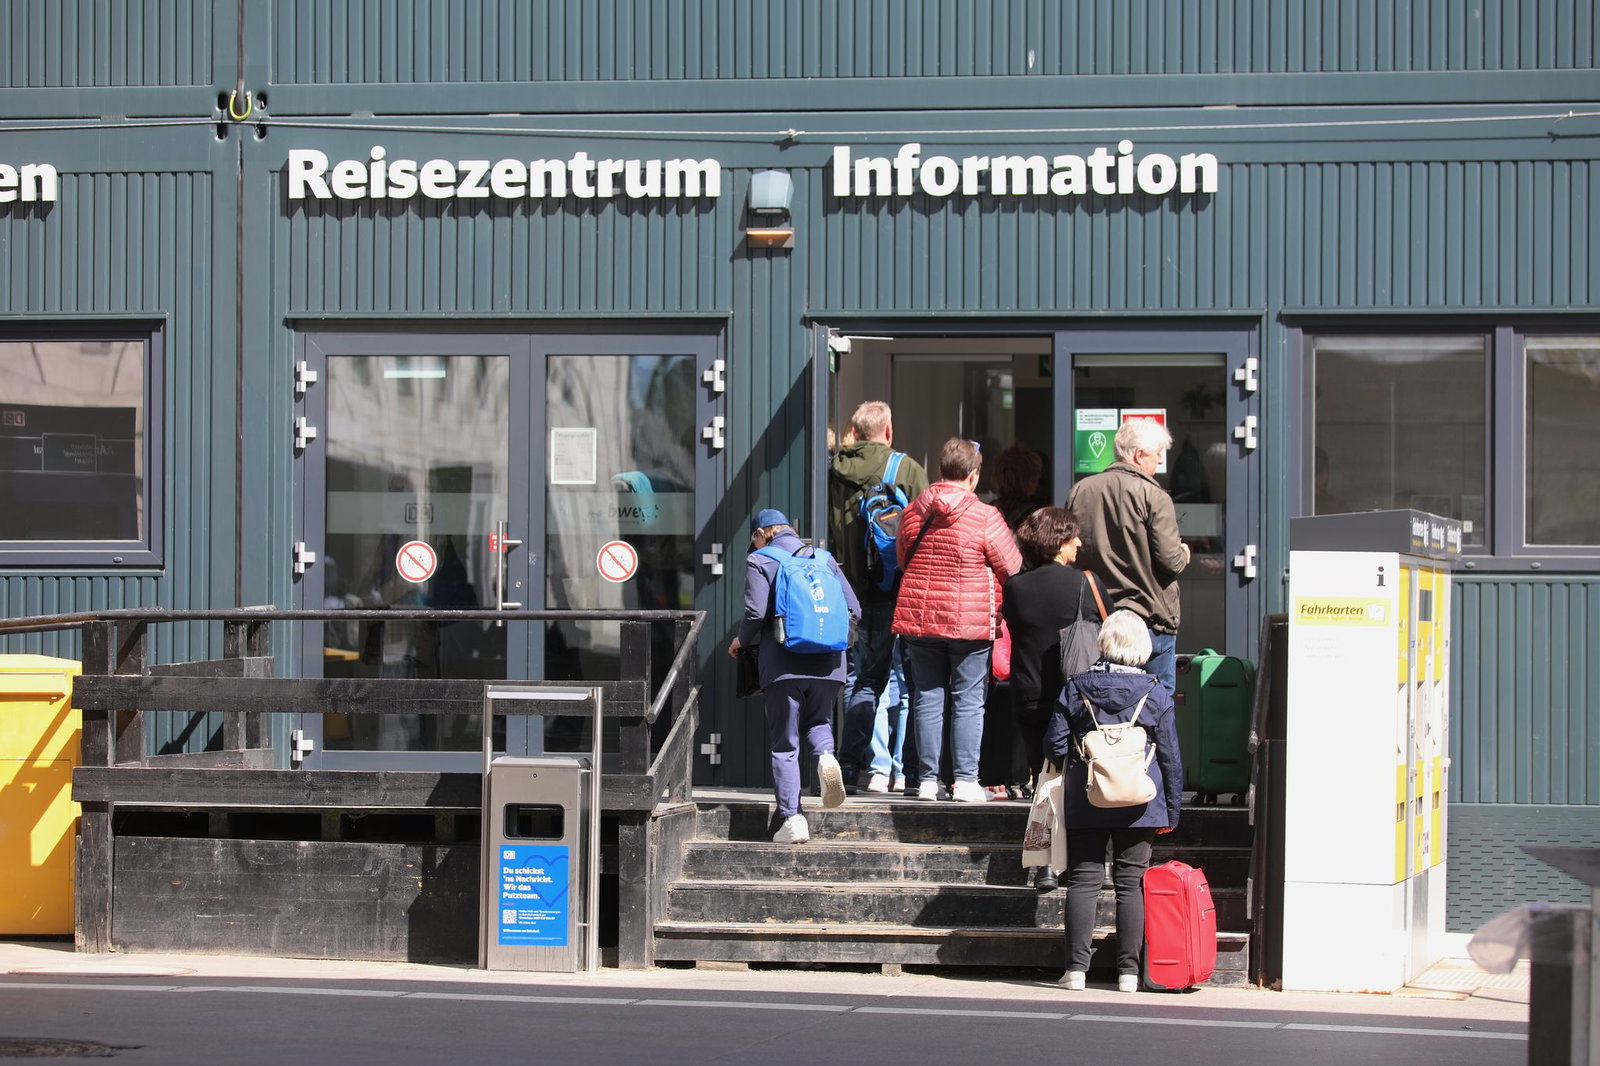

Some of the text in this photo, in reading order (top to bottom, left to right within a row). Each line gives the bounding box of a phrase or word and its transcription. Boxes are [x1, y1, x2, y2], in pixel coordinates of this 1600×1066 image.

[287, 145, 721, 200] Reisezentrum
[832, 139, 1219, 197] Information
[1300, 604, 1364, 616] Fahrkarten
[515, 867, 545, 875] schickst
[516, 875, 553, 883] Nachricht.
[503, 883, 532, 891] Wir das
